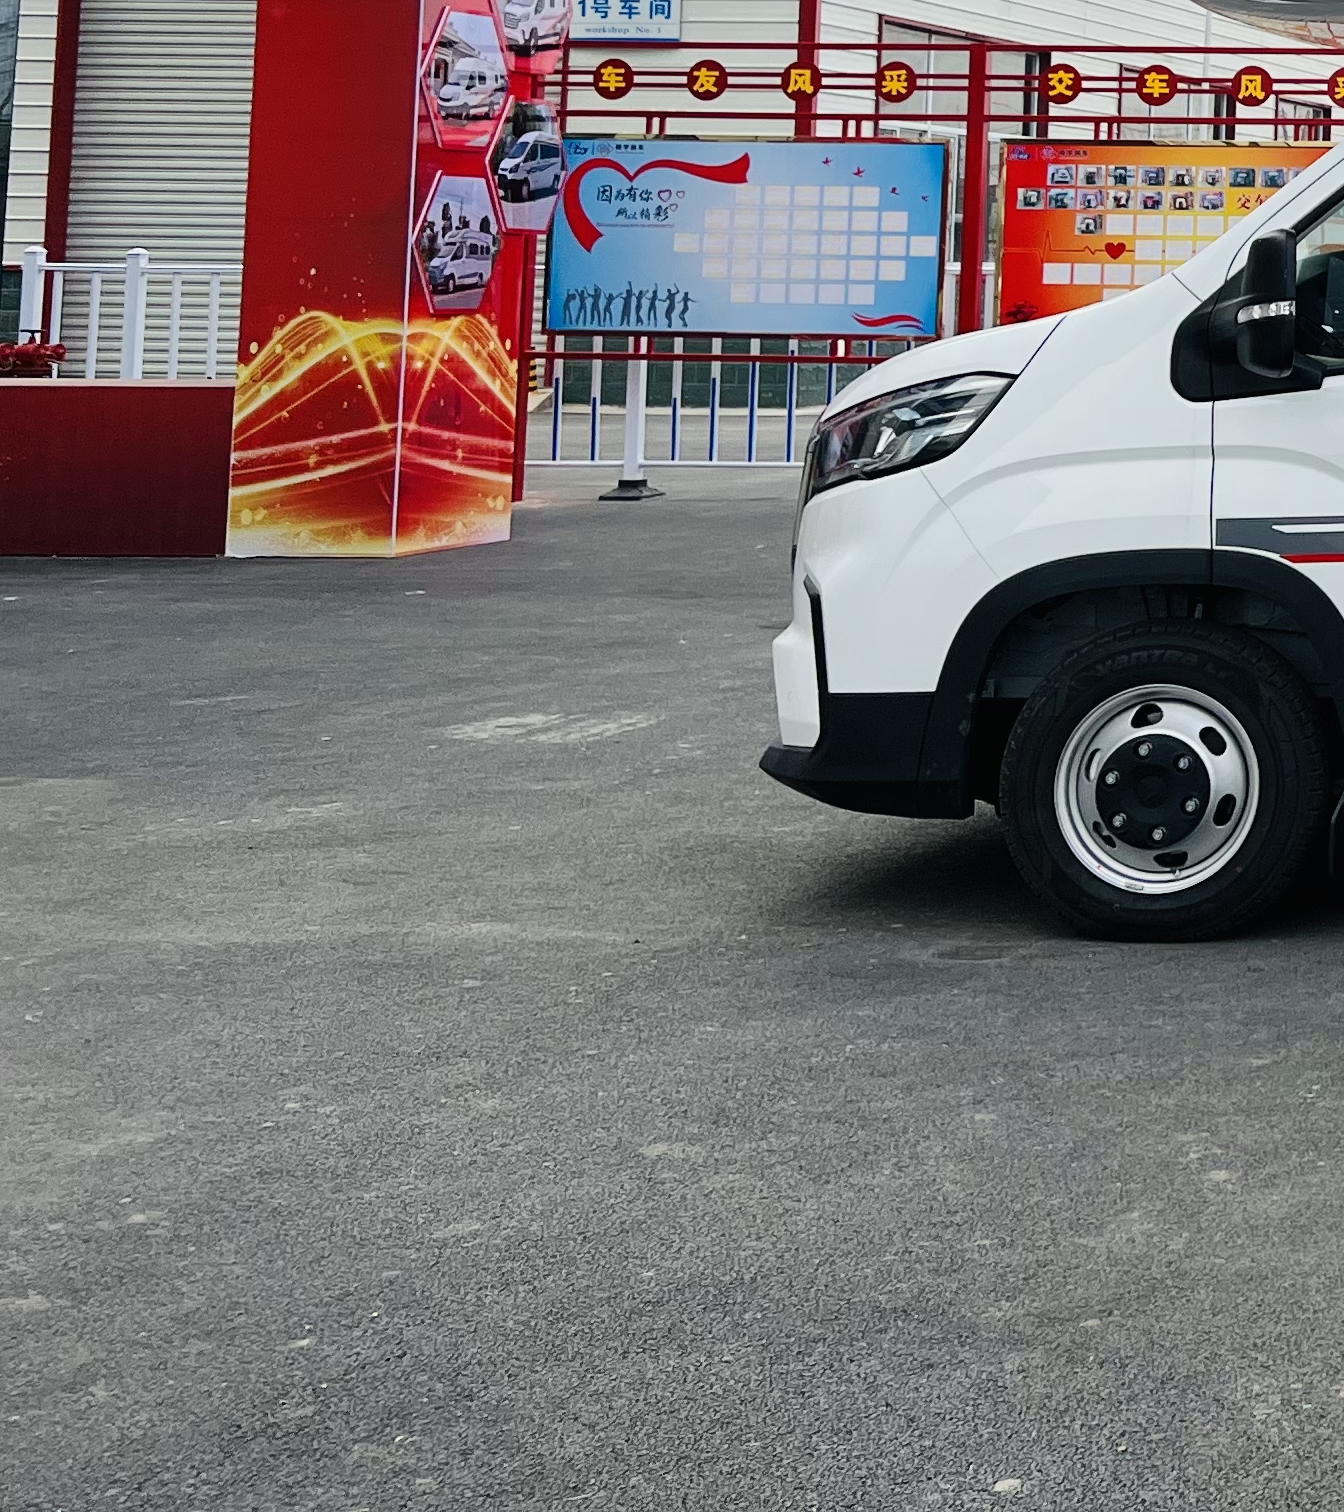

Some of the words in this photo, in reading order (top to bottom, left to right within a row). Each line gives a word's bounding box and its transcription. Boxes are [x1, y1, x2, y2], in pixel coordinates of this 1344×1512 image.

[599, 66, 908, 95] 车友风采
[597, 184, 653, 204] 因为有你
